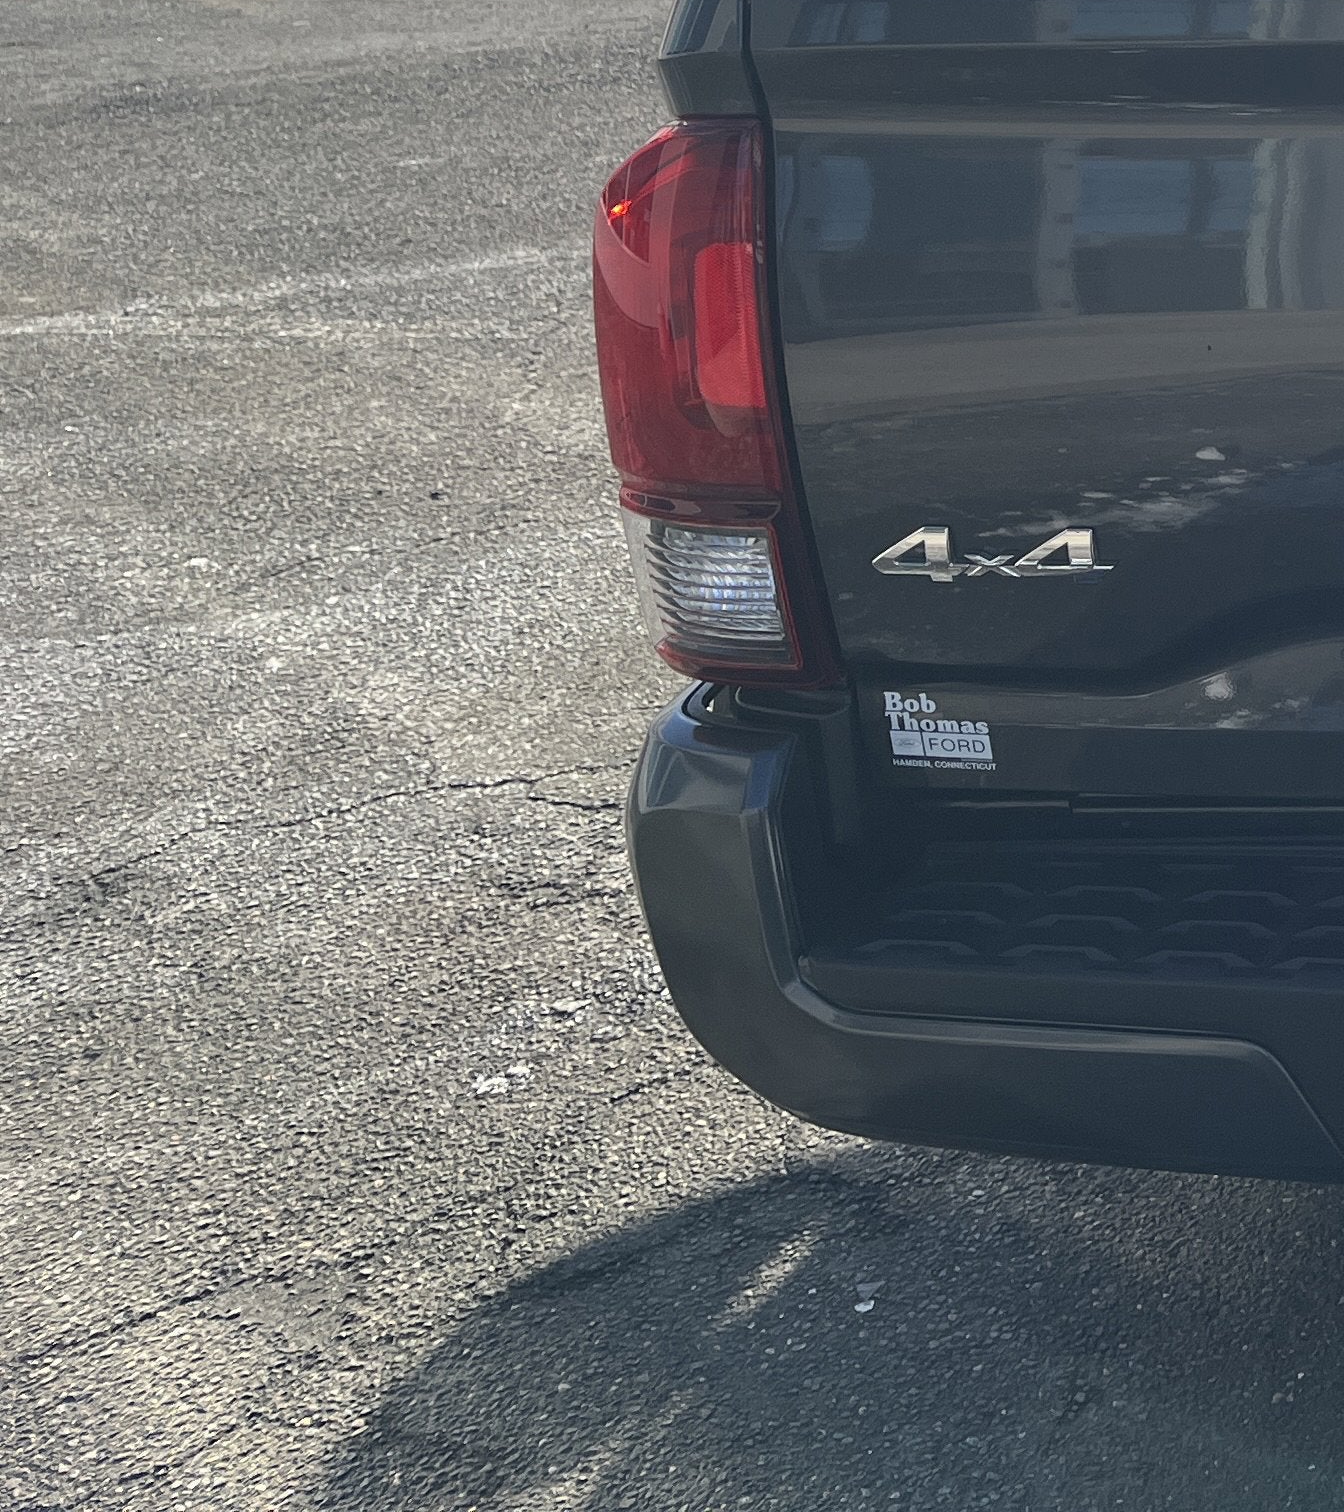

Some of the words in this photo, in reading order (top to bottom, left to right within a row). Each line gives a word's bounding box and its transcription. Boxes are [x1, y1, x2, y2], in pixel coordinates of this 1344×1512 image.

[883, 691, 937, 714] Bob
[884, 711, 990, 734] Thomas
[928, 737, 986, 753] FORD
